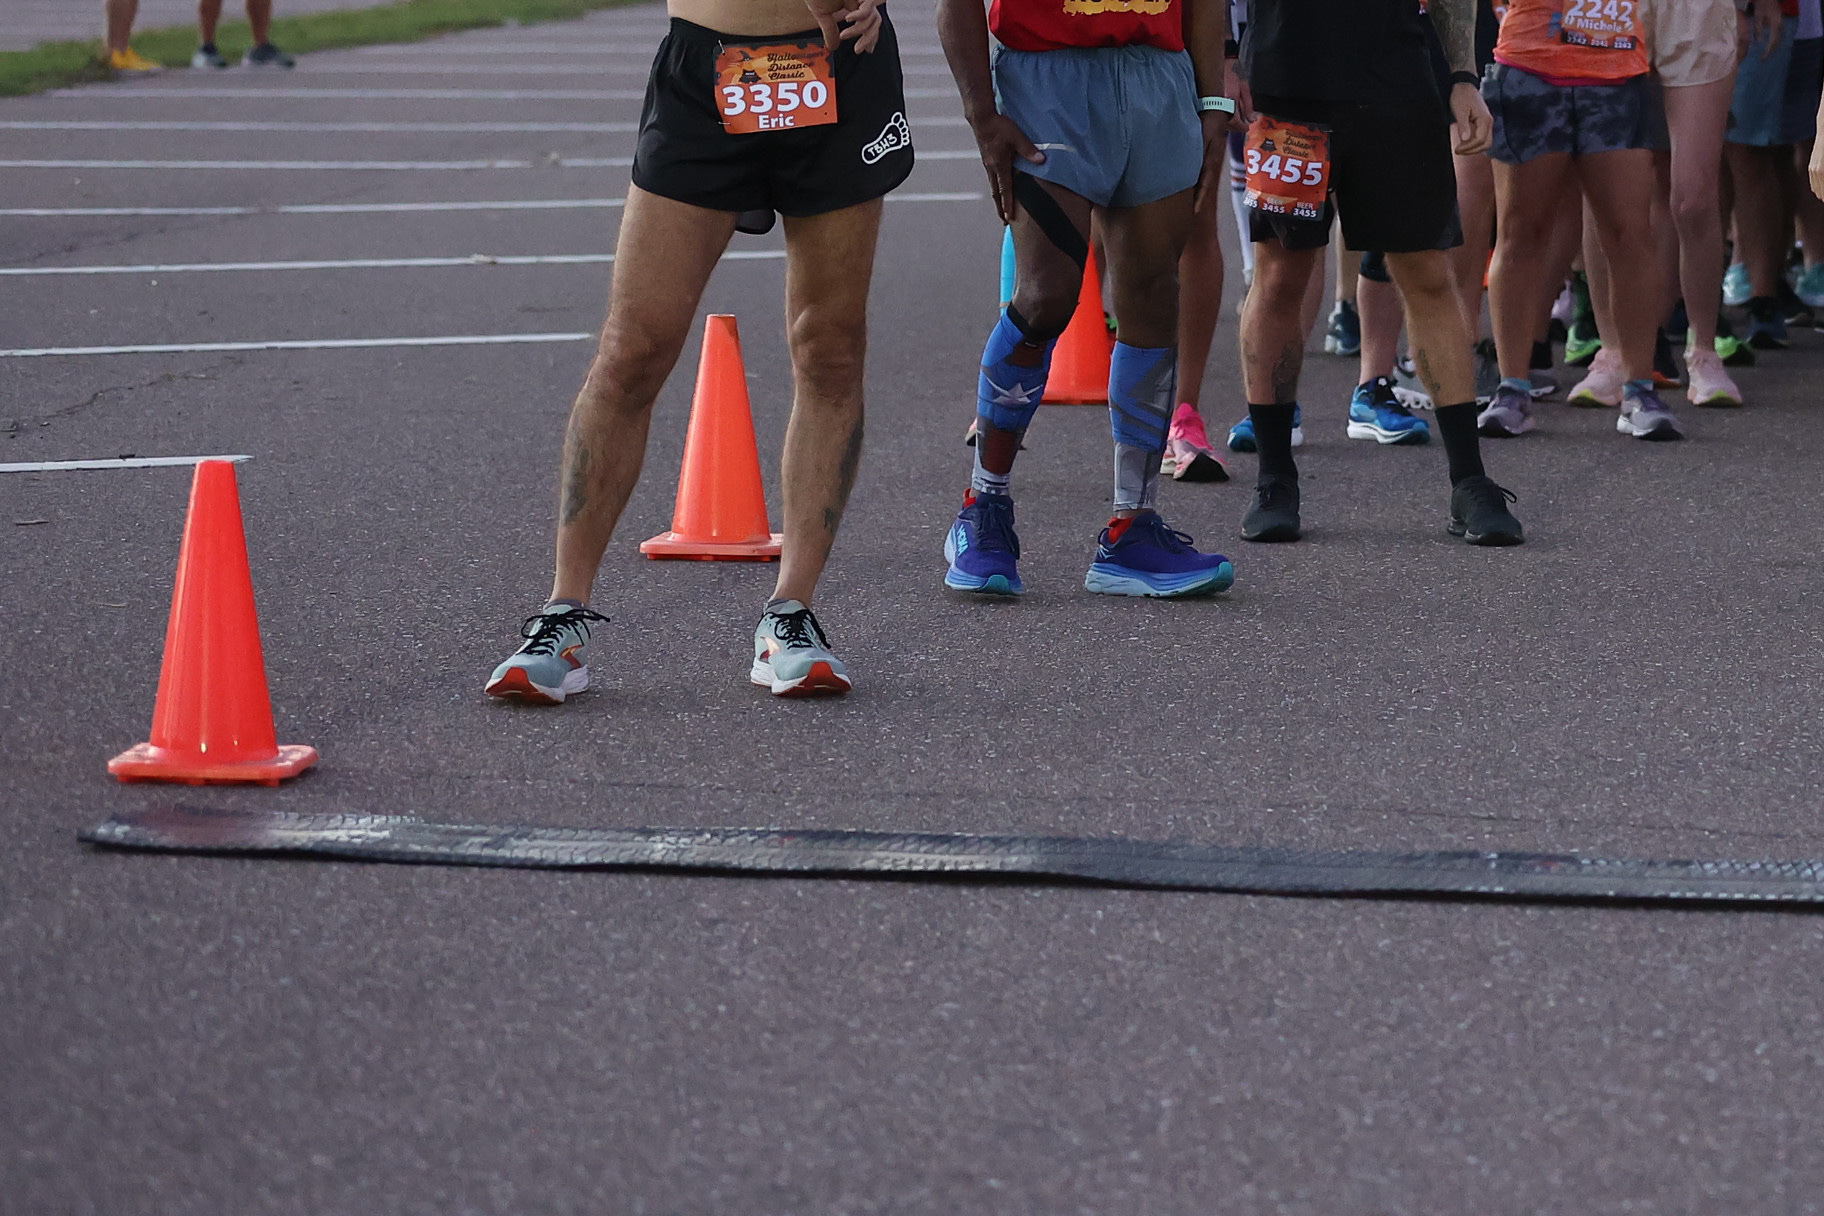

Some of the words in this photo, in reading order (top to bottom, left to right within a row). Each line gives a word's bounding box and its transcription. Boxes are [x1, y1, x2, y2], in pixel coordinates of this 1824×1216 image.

[1577, 18, 1622, 32] Michele
[768, 62, 814, 72] Distance
[768, 72, 805, 80] Classic
[722, 81, 827, 116] 3350
[758, 114, 794, 129] Eric
[867, 133, 897, 157] TBH3
[1247, 150, 1322, 186] 3455
[1262, 204, 1285, 213] 3455
[1293, 208, 1317, 217] 3455
